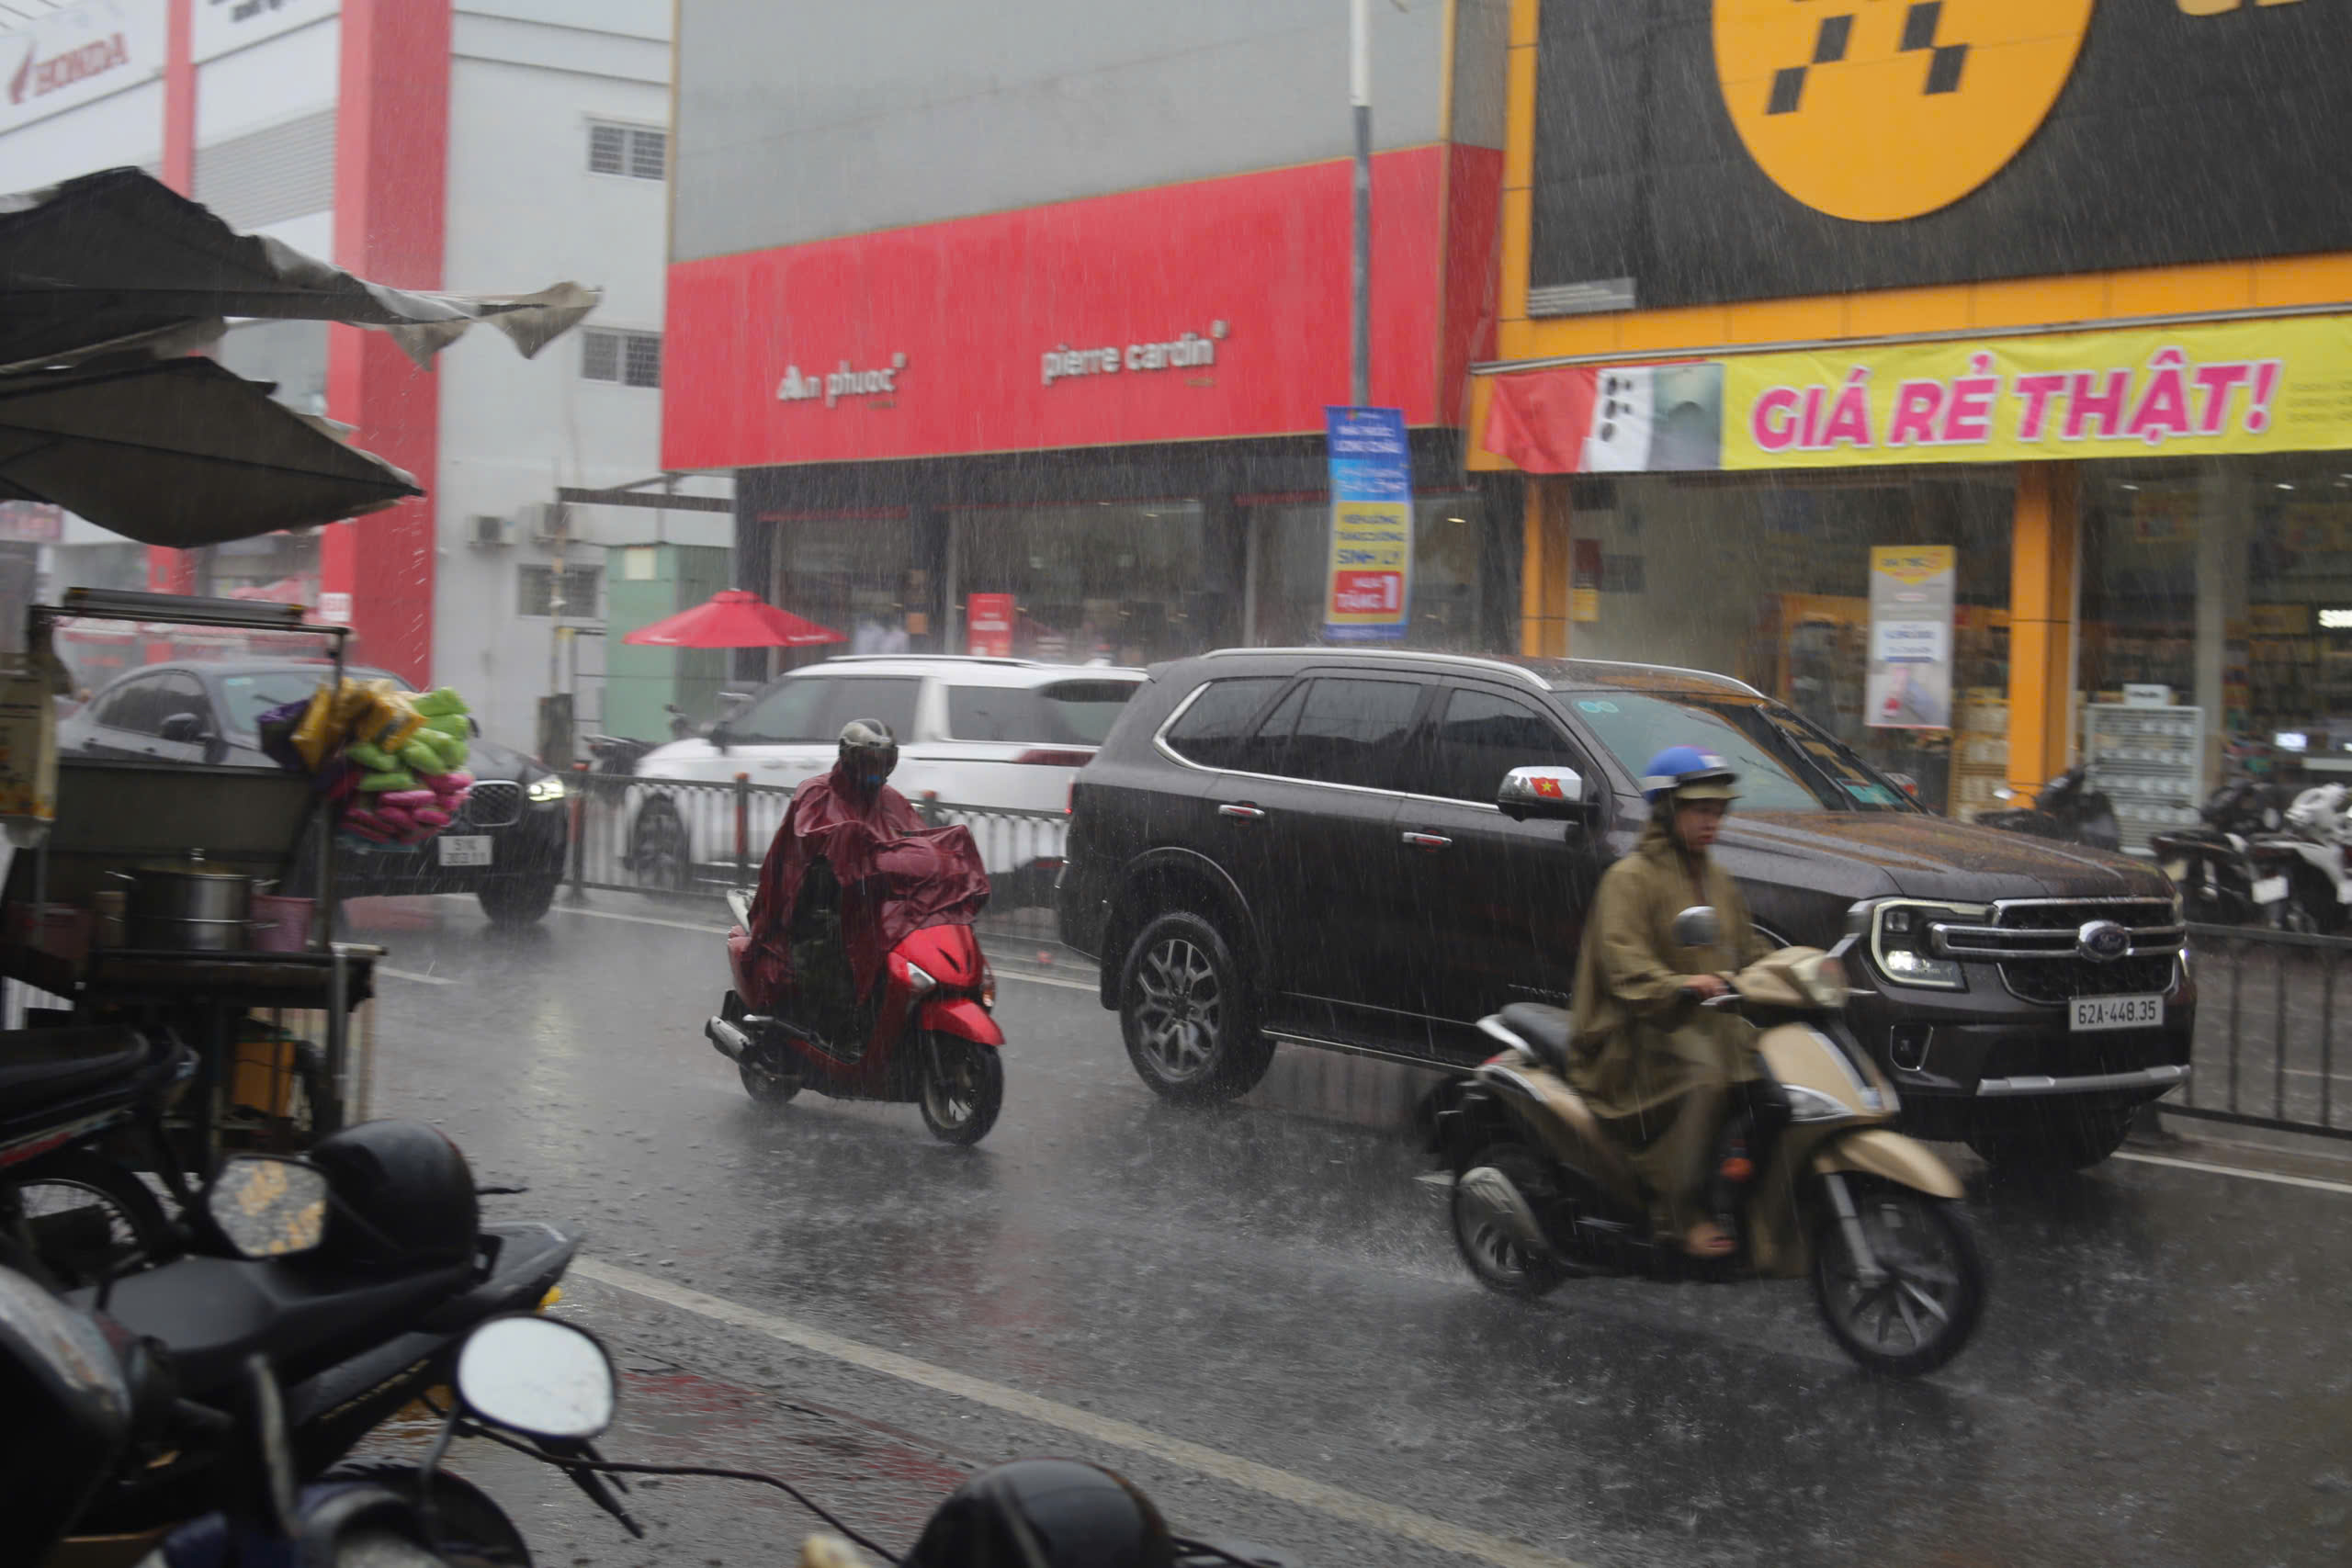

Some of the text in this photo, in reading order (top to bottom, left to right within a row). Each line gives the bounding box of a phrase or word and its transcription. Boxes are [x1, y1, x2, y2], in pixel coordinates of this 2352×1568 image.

[1042, 332, 1215, 386] pierre cardin
[1751, 365, 1874, 452] GIÁ
[1885, 350, 2001, 447] RẺ
[2012, 346, 2283, 446] THẬT!
